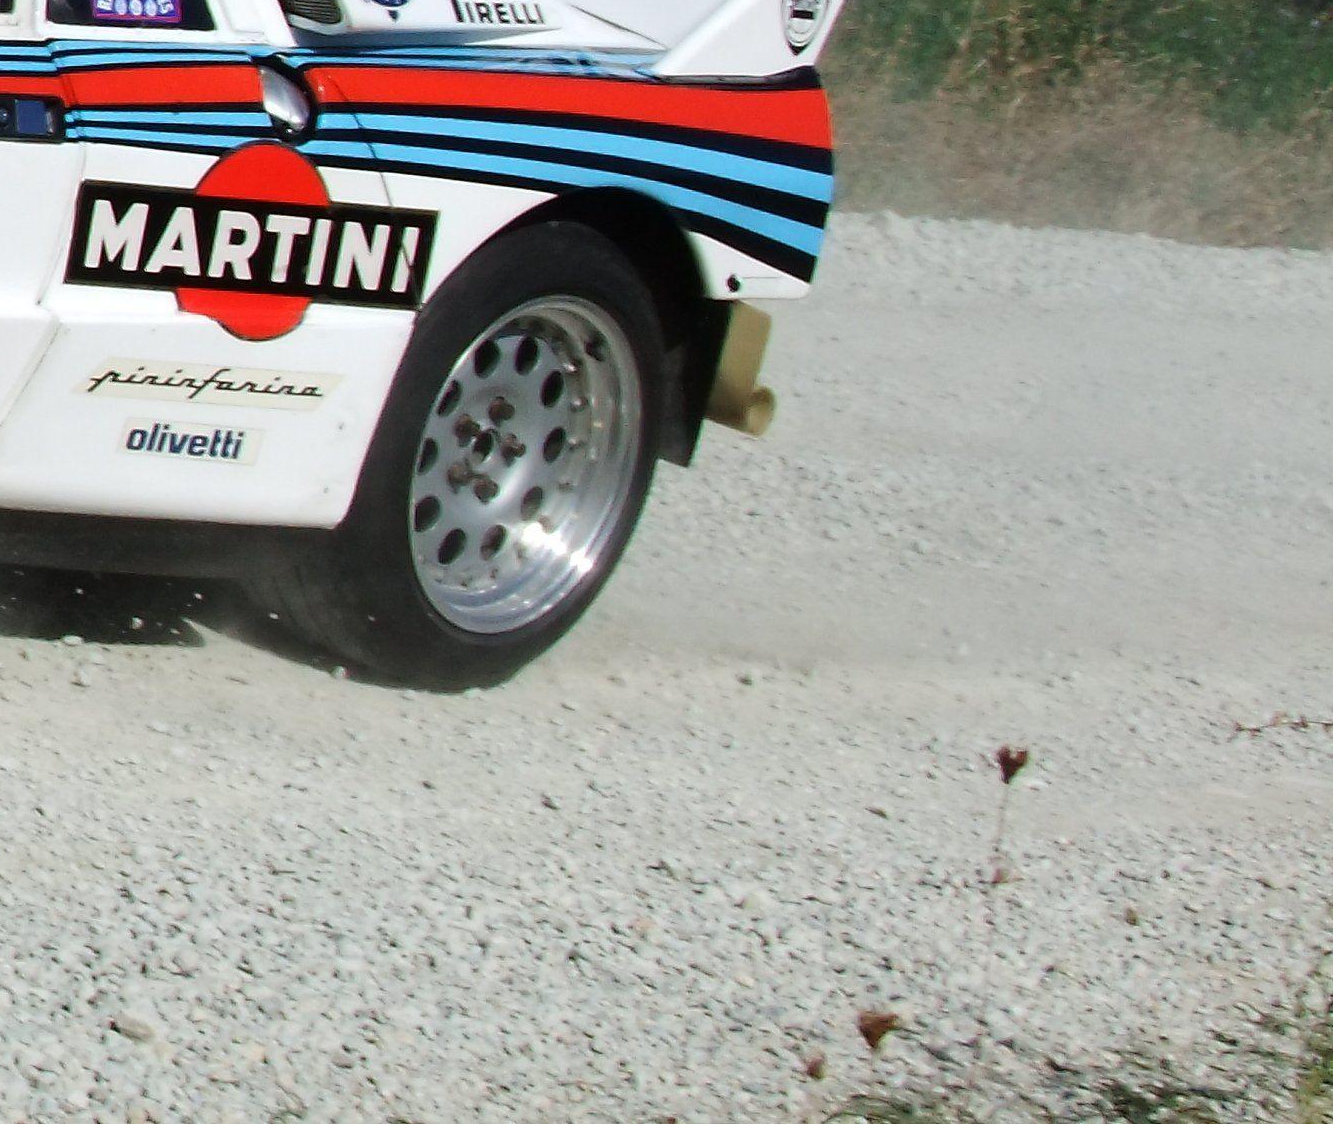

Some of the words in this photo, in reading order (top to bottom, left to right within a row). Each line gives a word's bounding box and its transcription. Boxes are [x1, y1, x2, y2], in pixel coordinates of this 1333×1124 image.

[84, 200, 420, 294] MARTINI
[87, 367, 323, 399] pininfarina
[126, 423, 245, 460] olivetti
